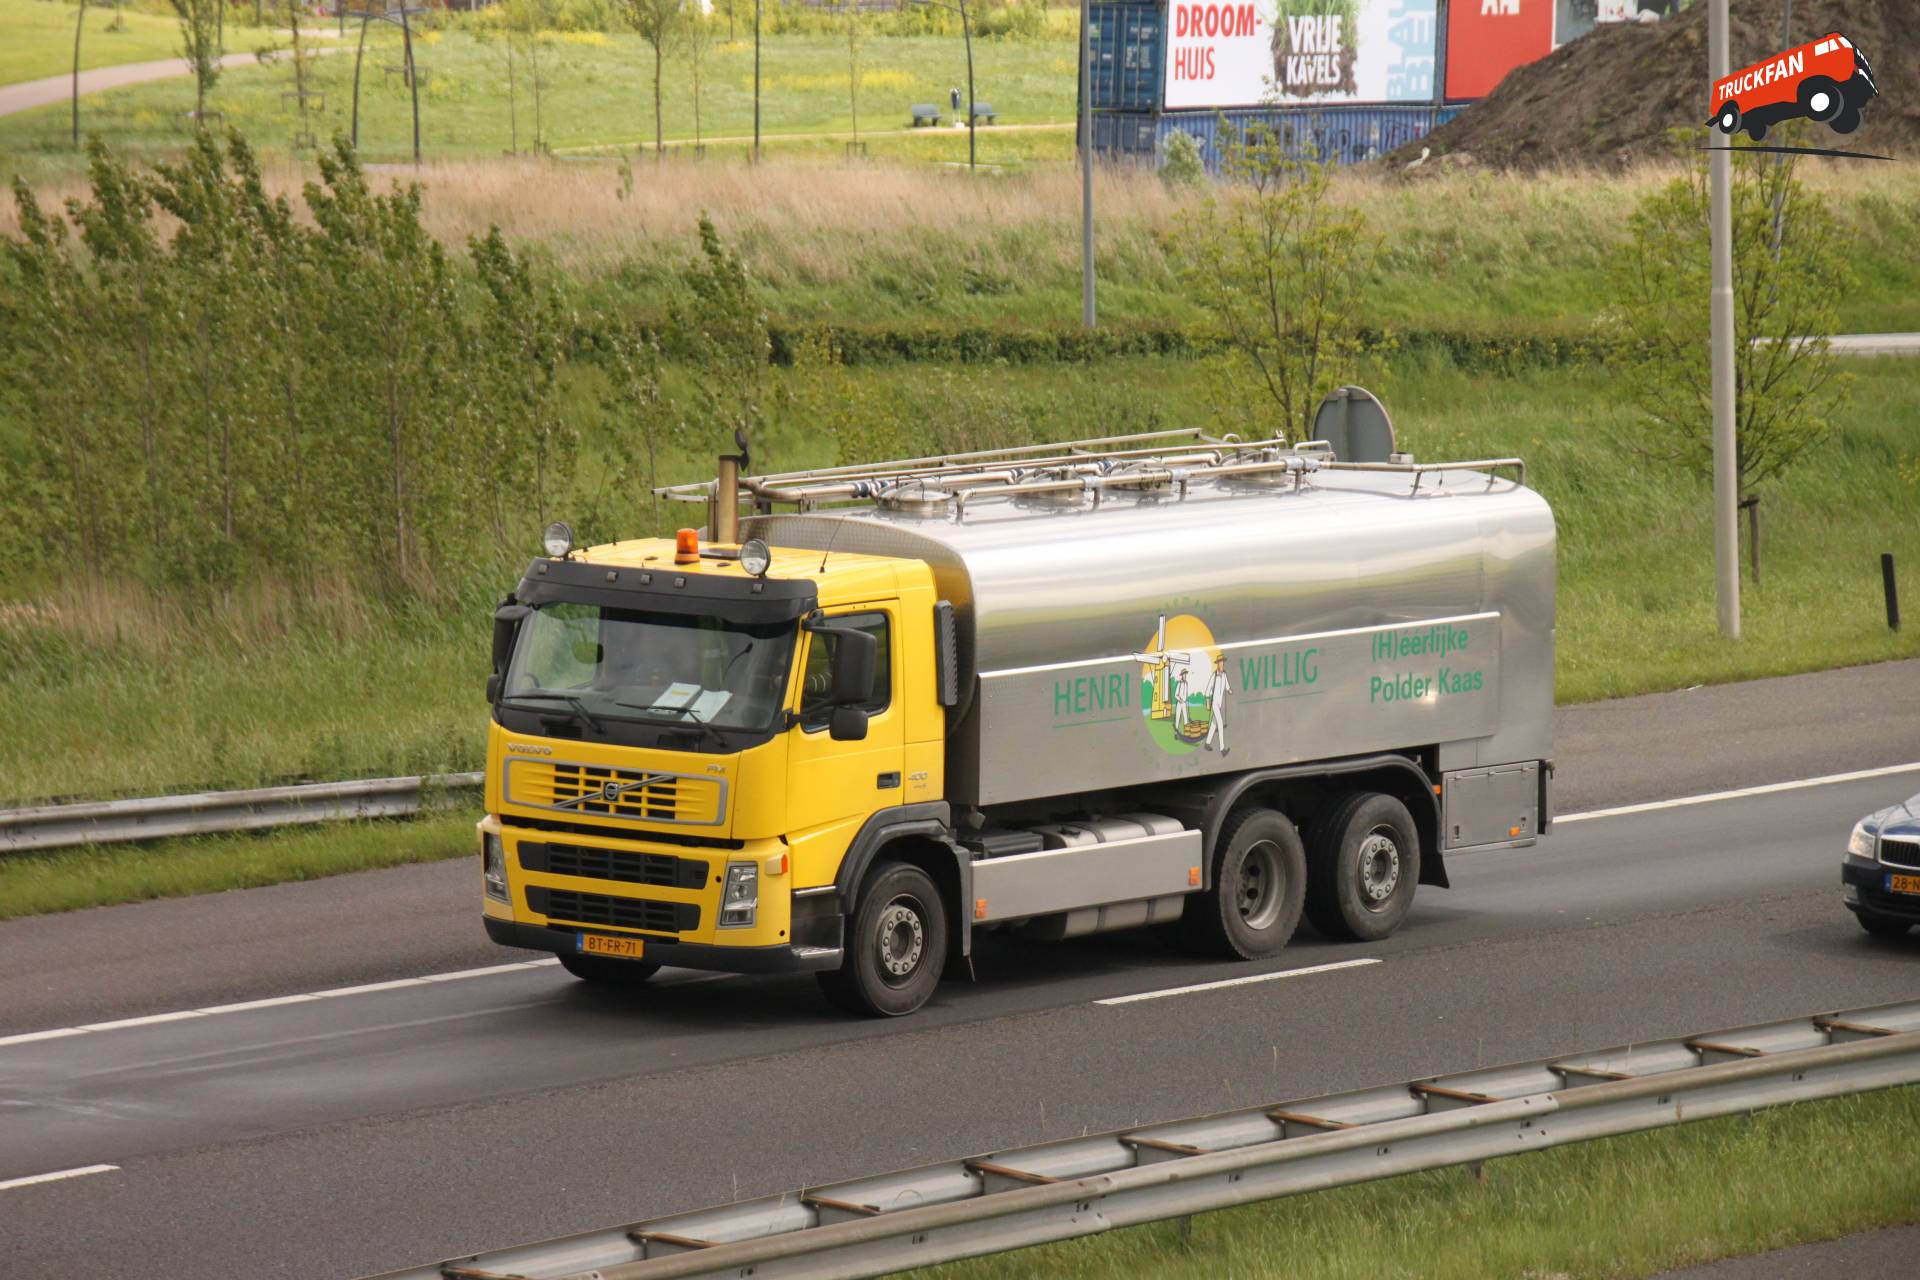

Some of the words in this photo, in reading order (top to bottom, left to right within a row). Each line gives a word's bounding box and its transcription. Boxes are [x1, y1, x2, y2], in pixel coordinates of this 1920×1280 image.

[1176, 4, 1262, 38] DROOM-
[1288, 15, 1342, 54] VRIJE
[1175, 46, 1215, 80] HUIS
[1286, 54, 1341, 86] KAVELS
[1055, 671, 1130, 716] HENRI
[1239, 647, 1318, 693] WILLIG
[1370, 671, 1432, 704] Polder
[1438, 667, 1483, 695] Kaas
[507, 743, 552, 756] VOLVO
[588, 936, 637, 955] BT-FR-71
